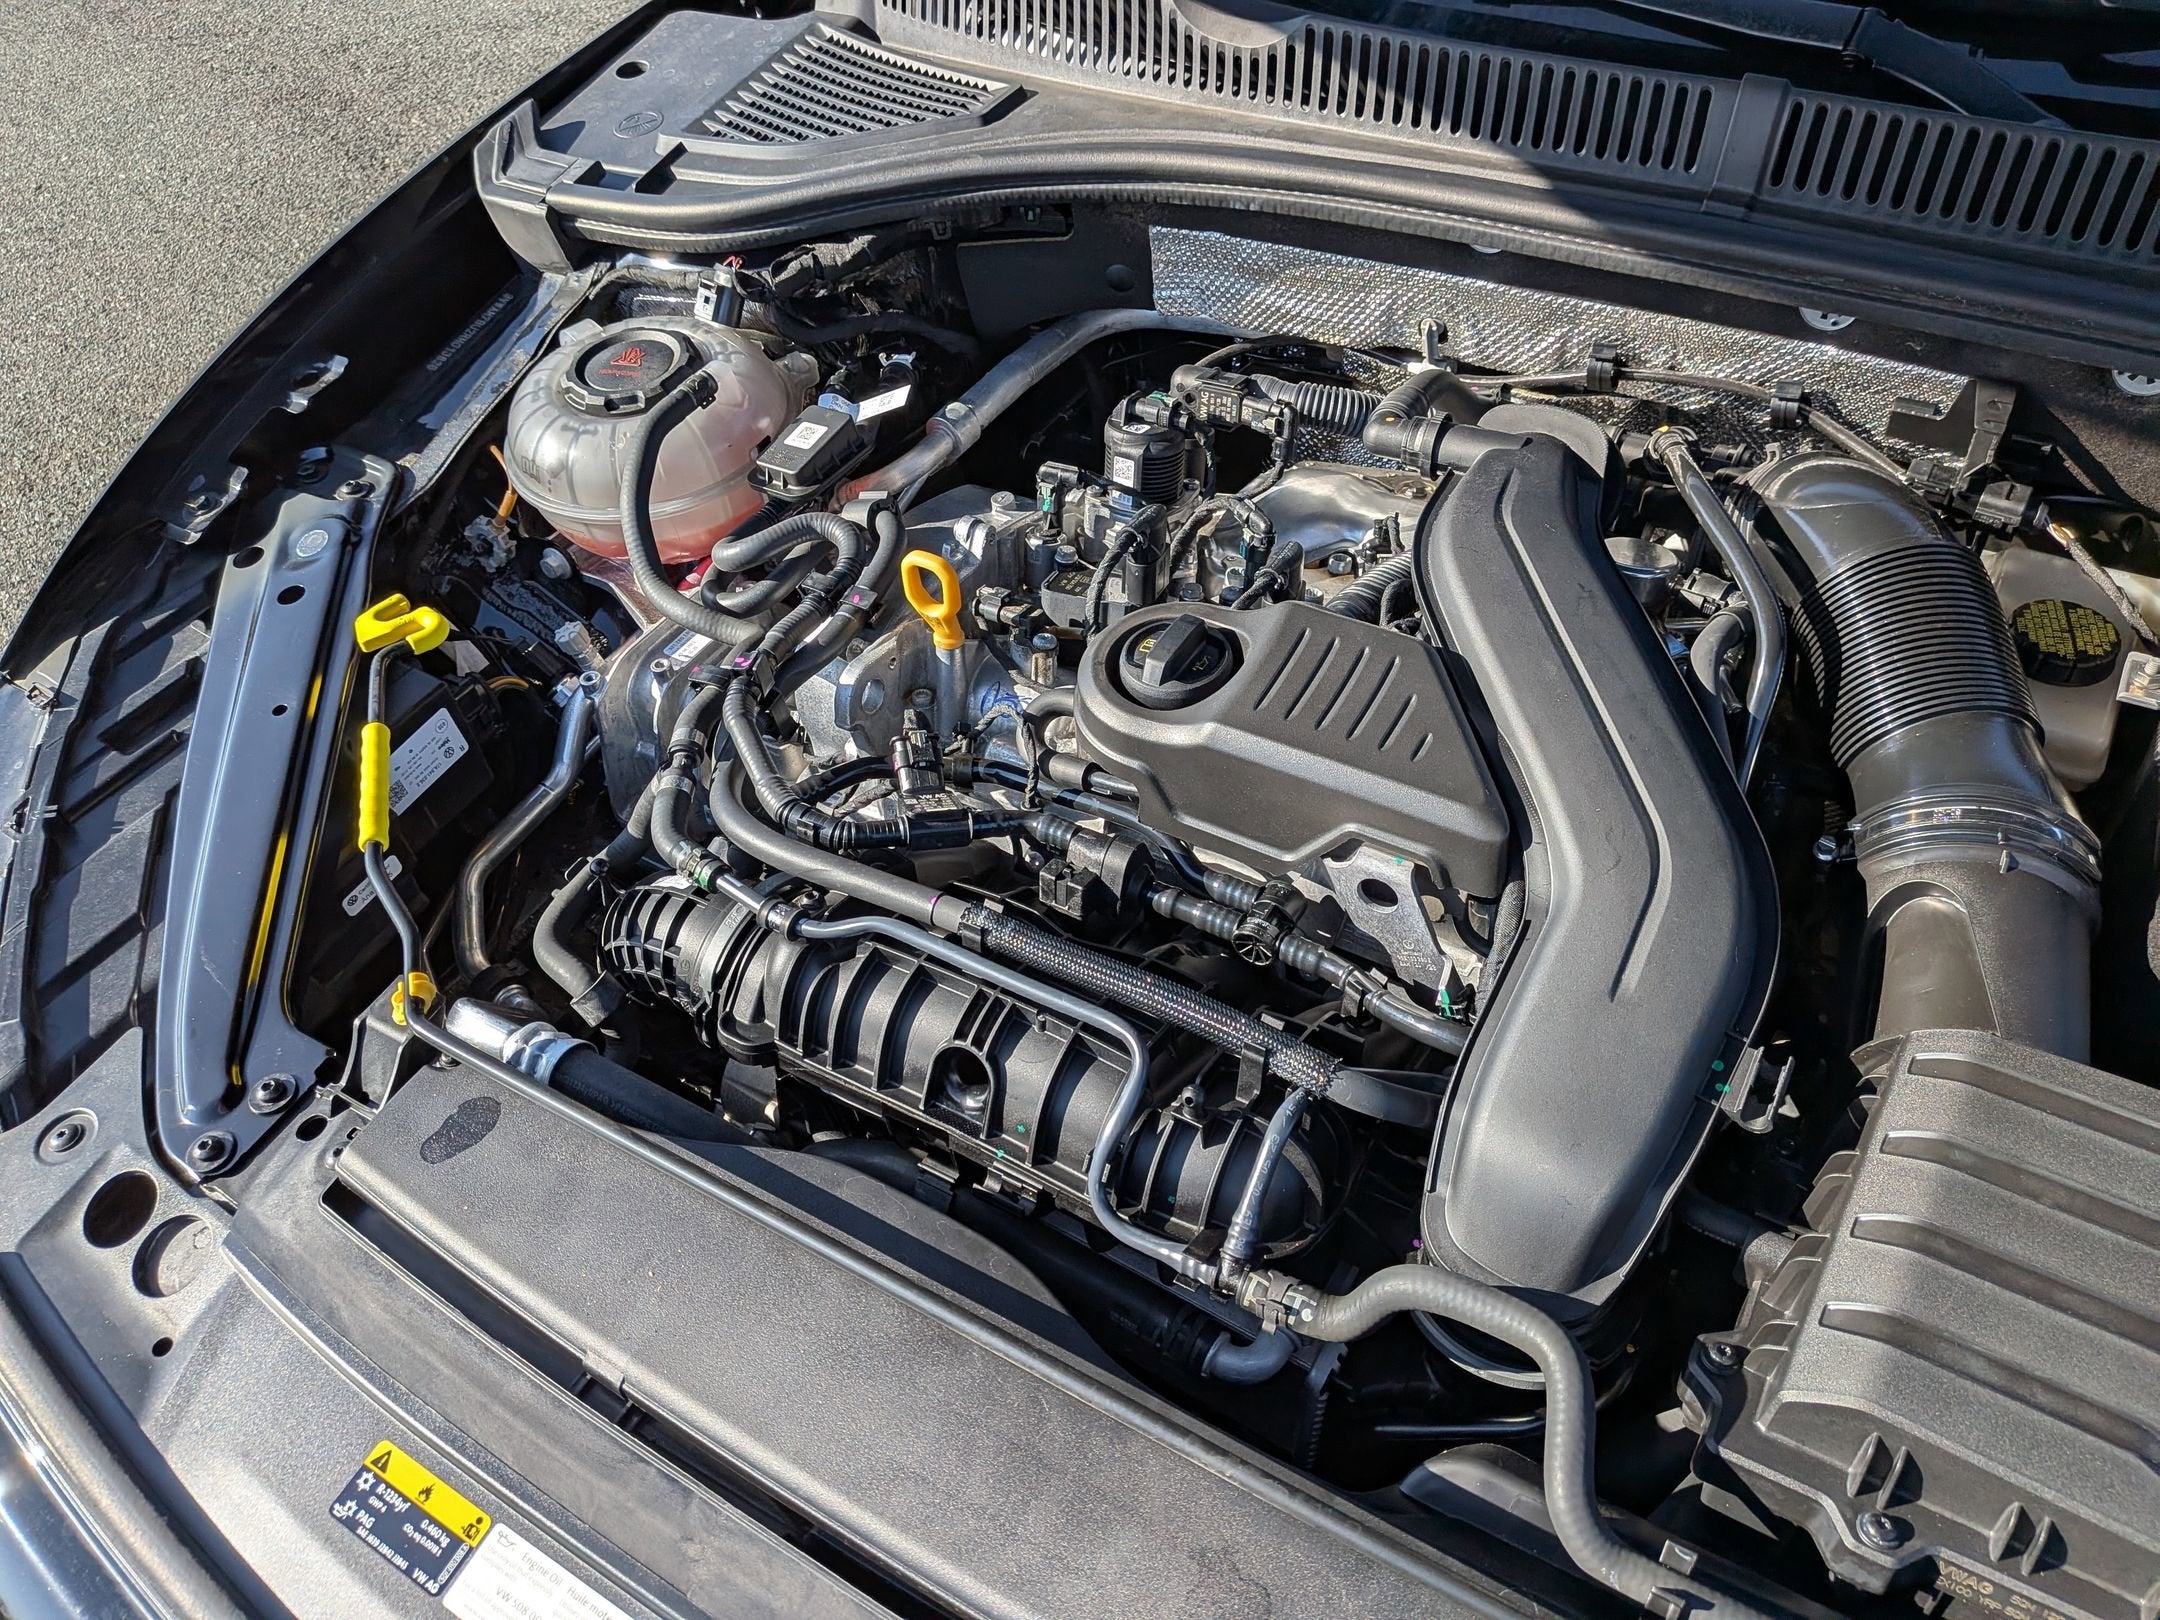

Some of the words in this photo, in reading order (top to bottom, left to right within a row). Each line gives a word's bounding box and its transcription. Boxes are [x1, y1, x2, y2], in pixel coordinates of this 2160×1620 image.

[1199, 390, 1209, 403] AG
[1199, 404, 1208, 418] VW
[376, 1484, 411, 1513] R-1234yf
[356, 1509, 376, 1529] PAG
[421, 1519, 442, 1538] 0.460
[438, 1532, 451, 1547] kg
[412, 1568, 429, 1584] VW
[425, 1578, 440, 1594] AG
[520, 1552, 548, 1578] Engine
[548, 1572, 564, 1587] Oil
[496, 1585, 513, 1603] VW
[511, 1598, 531, 1616] 508
[567, 1586, 591, 1606] Huile
